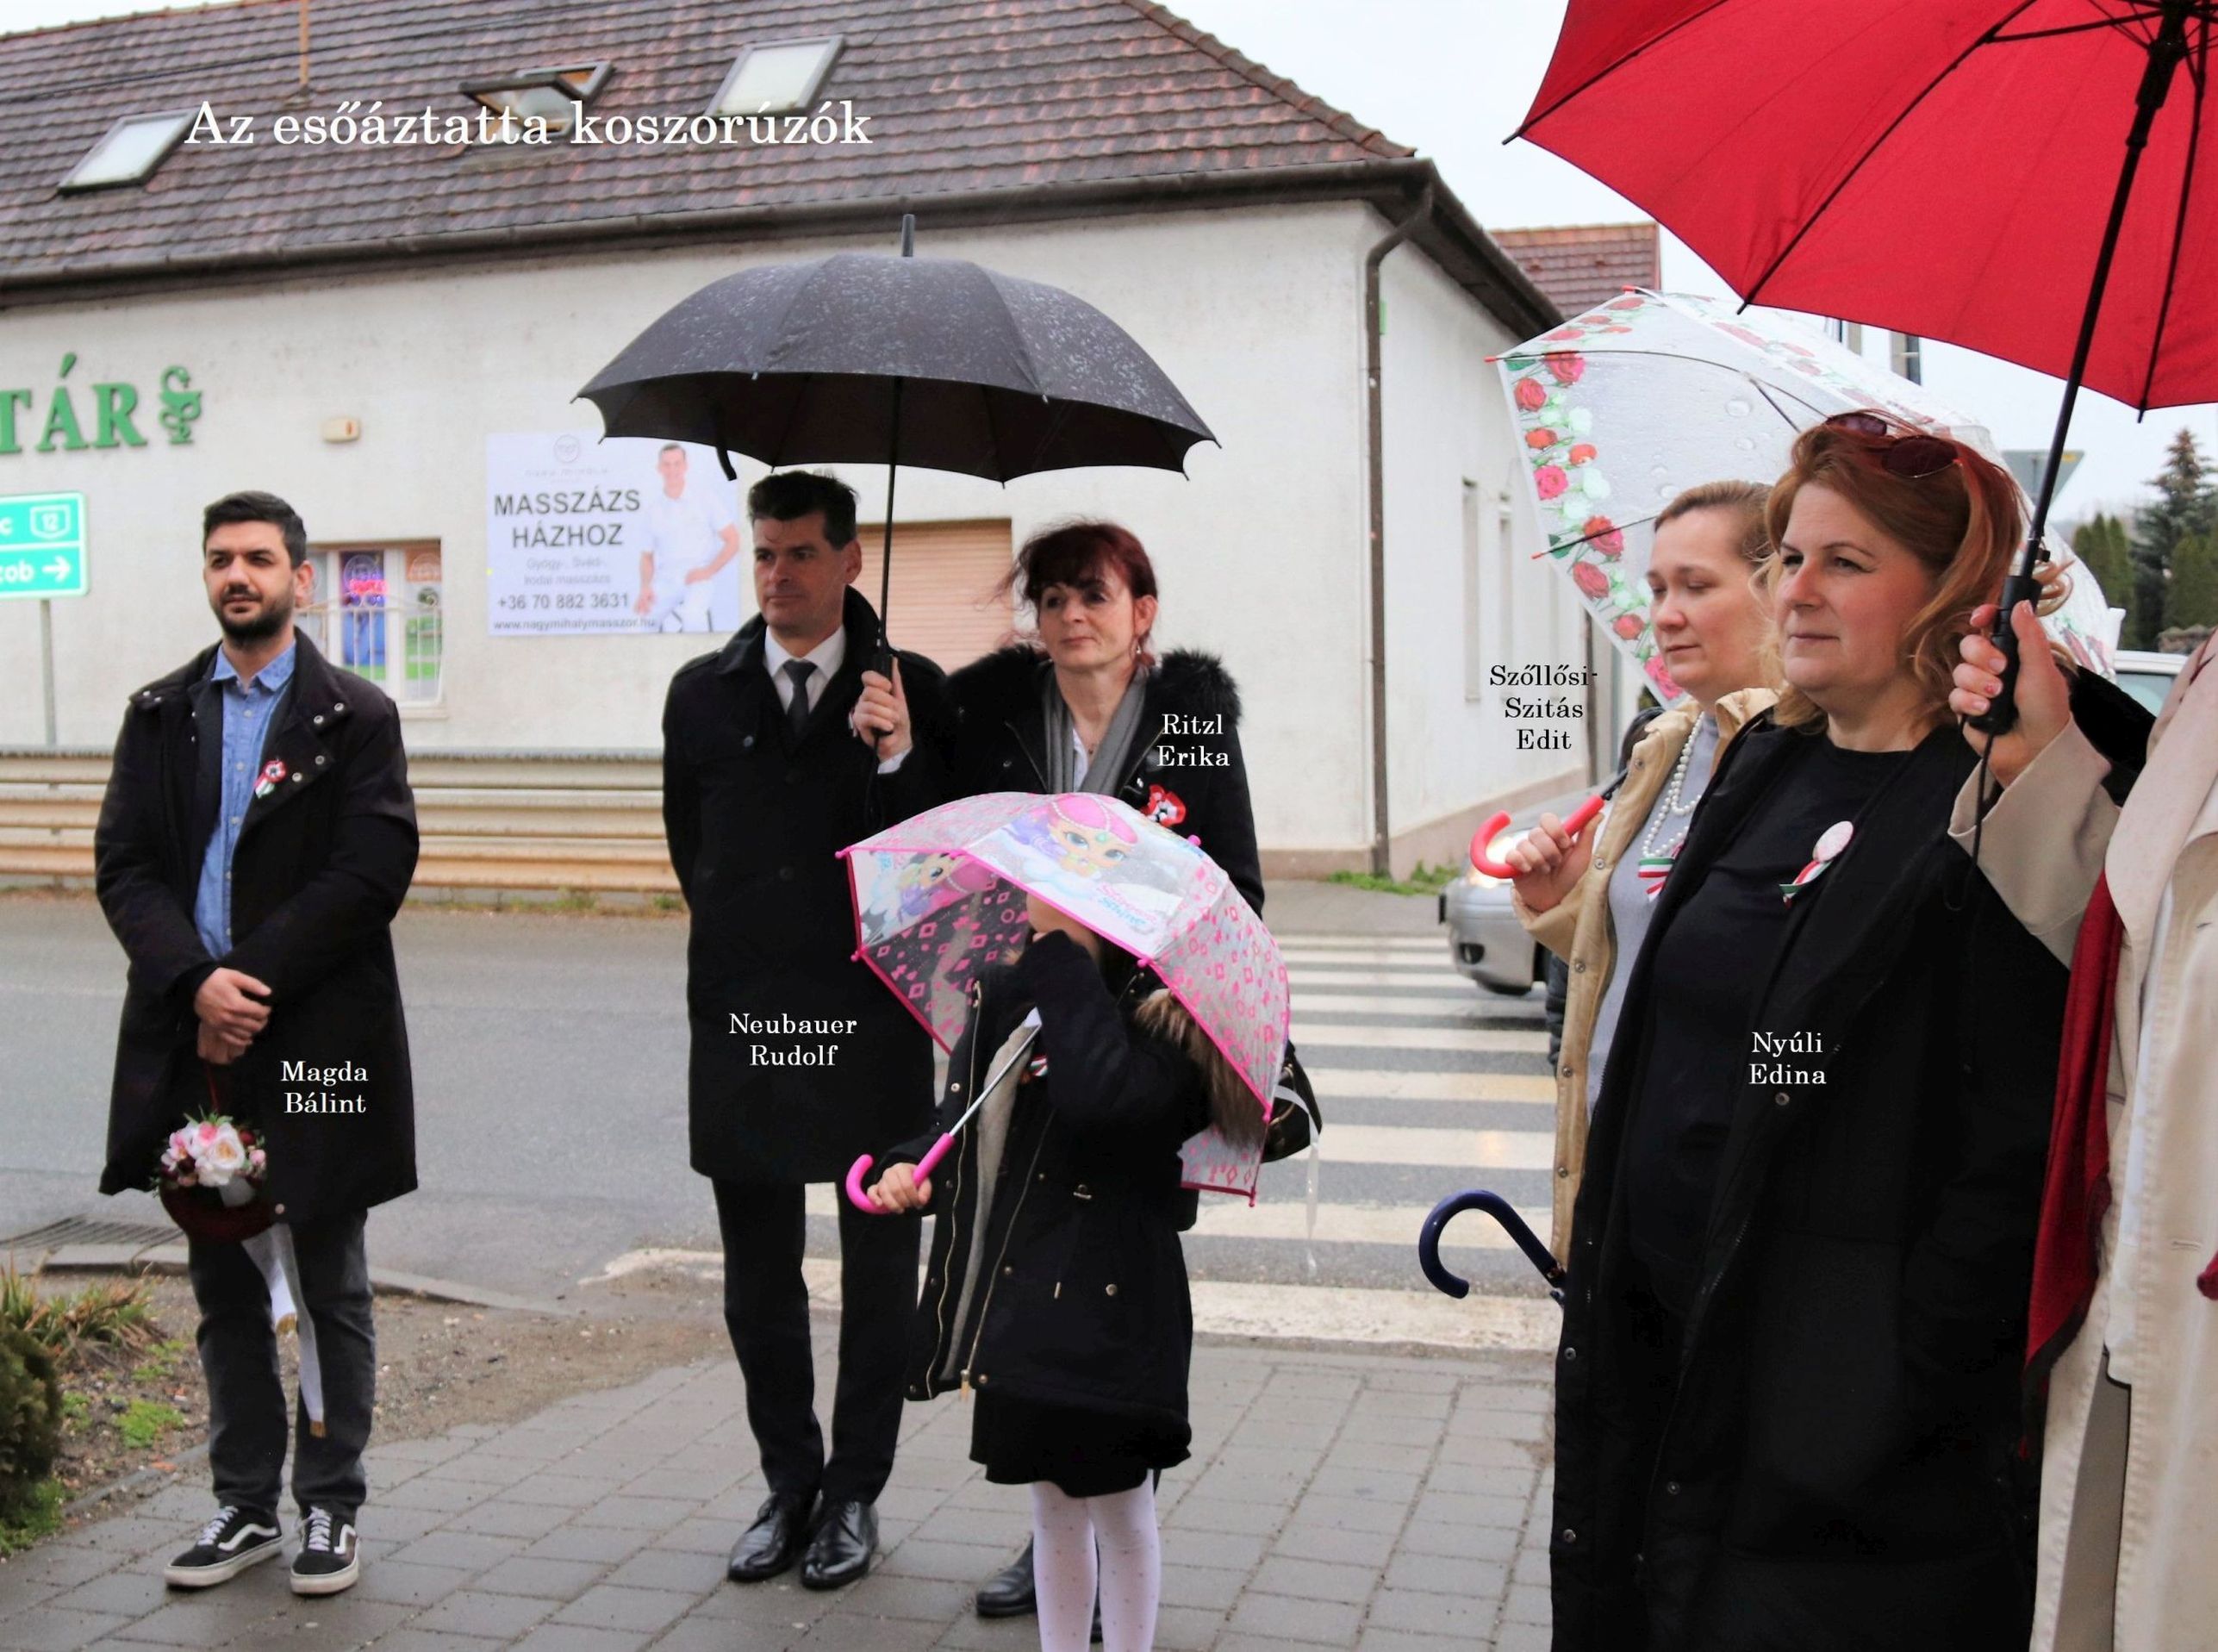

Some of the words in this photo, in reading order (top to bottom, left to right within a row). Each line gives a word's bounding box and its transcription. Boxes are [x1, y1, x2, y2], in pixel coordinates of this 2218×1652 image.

[494, 486, 641, 516] MASSZÁZS
[513, 521, 623, 548] HÁZHOZ
[498, 595, 526, 610] +36
[533, 594, 550, 609] 70
[556, 594, 584, 608] 882
[591, 593, 629, 608] 3631
